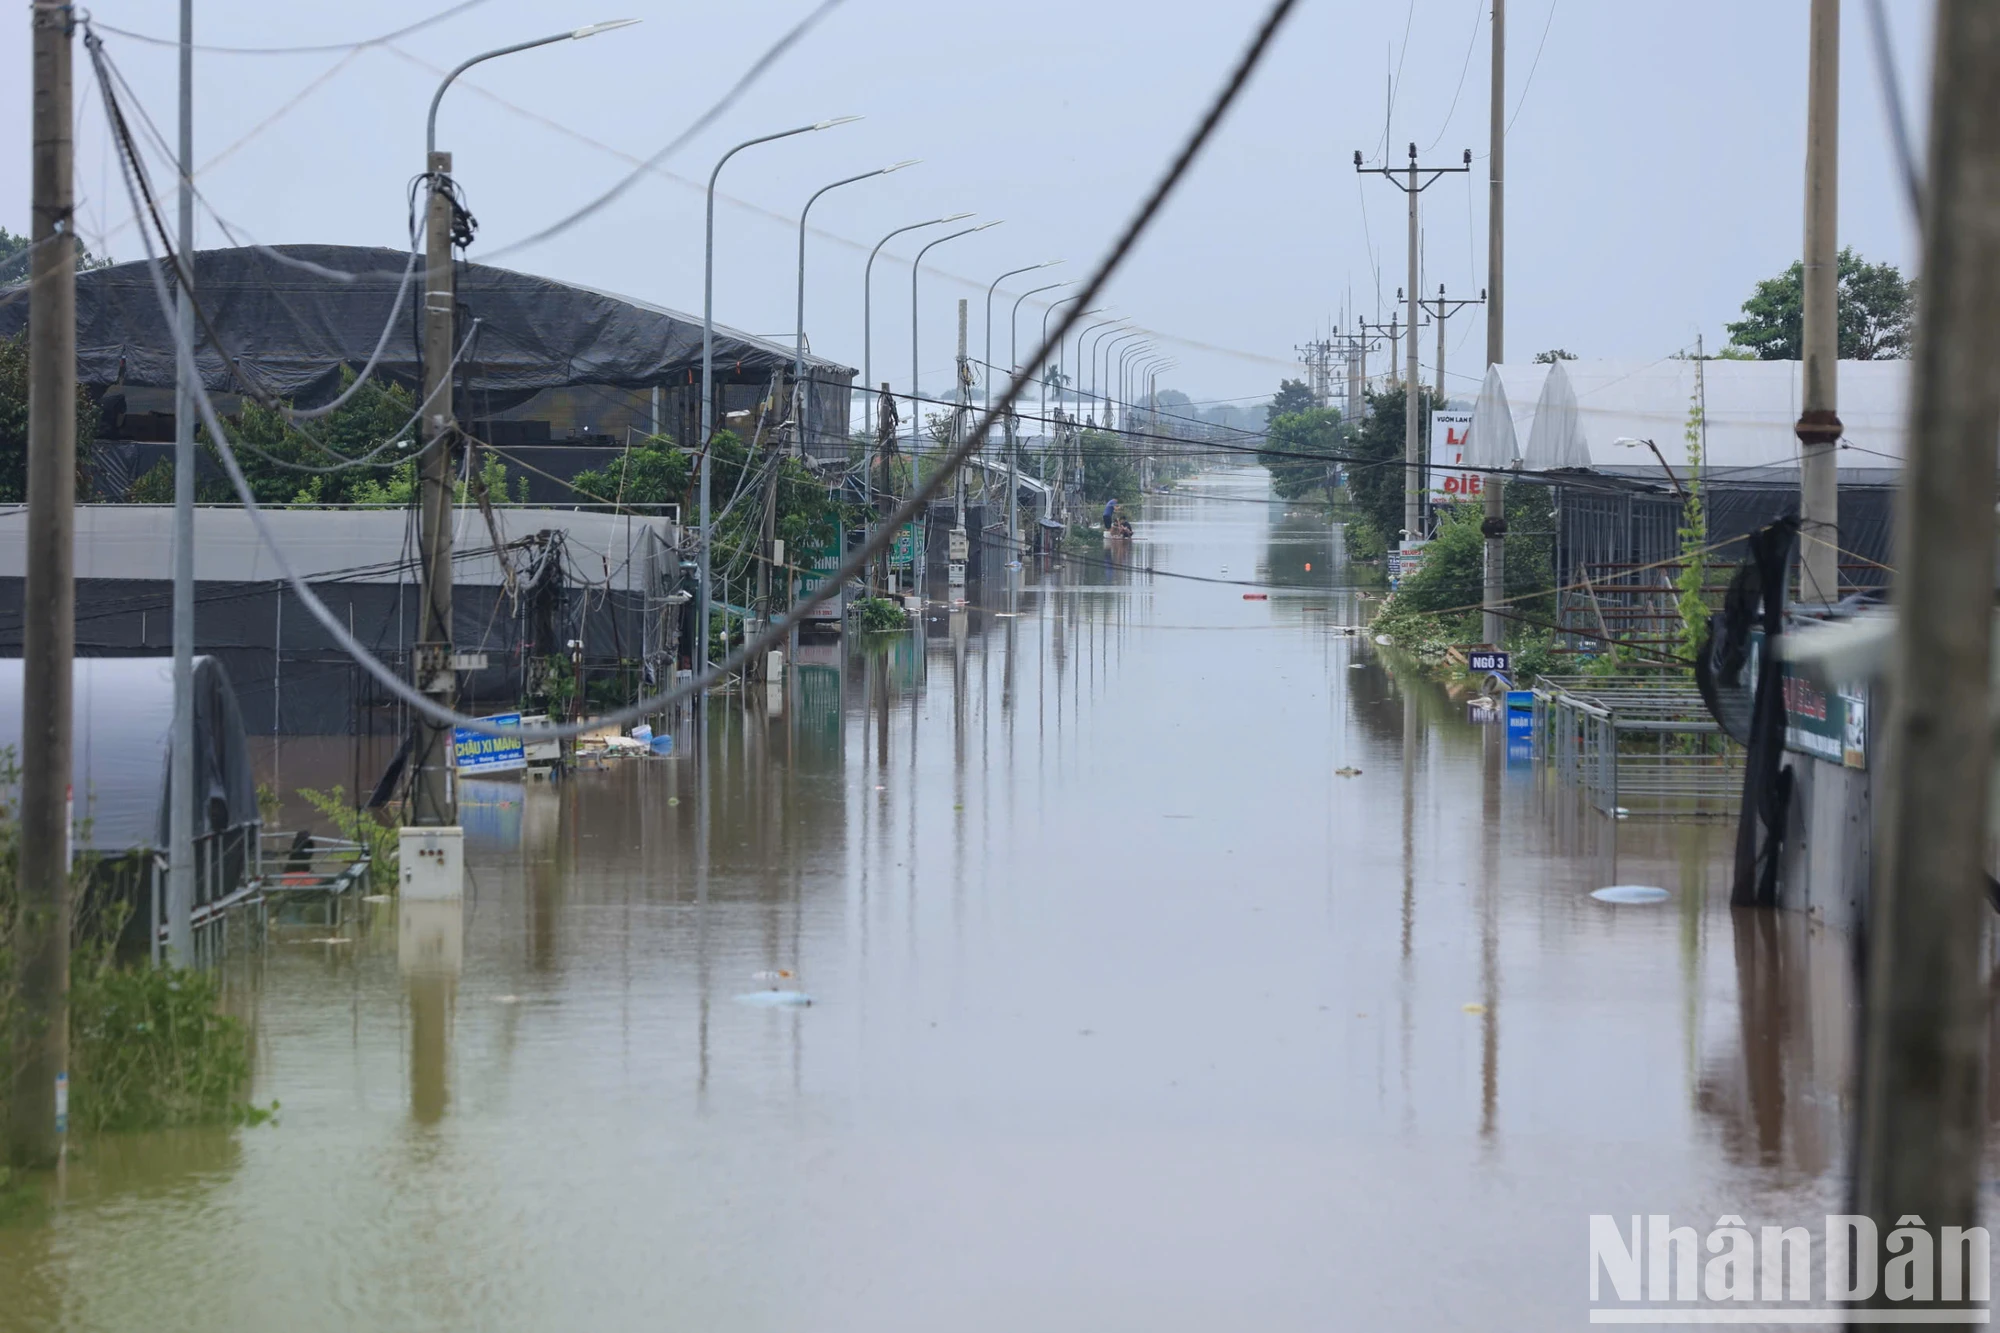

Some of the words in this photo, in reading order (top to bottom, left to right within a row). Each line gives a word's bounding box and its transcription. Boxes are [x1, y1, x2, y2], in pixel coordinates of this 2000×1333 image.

[1473, 655, 1495, 669] NGÕ
[1497, 657, 1505, 669] 3
[1510, 716, 1529, 729] NHẬN
[455, 739, 481, 758] CHẬU
[482, 738, 493, 754] XI
